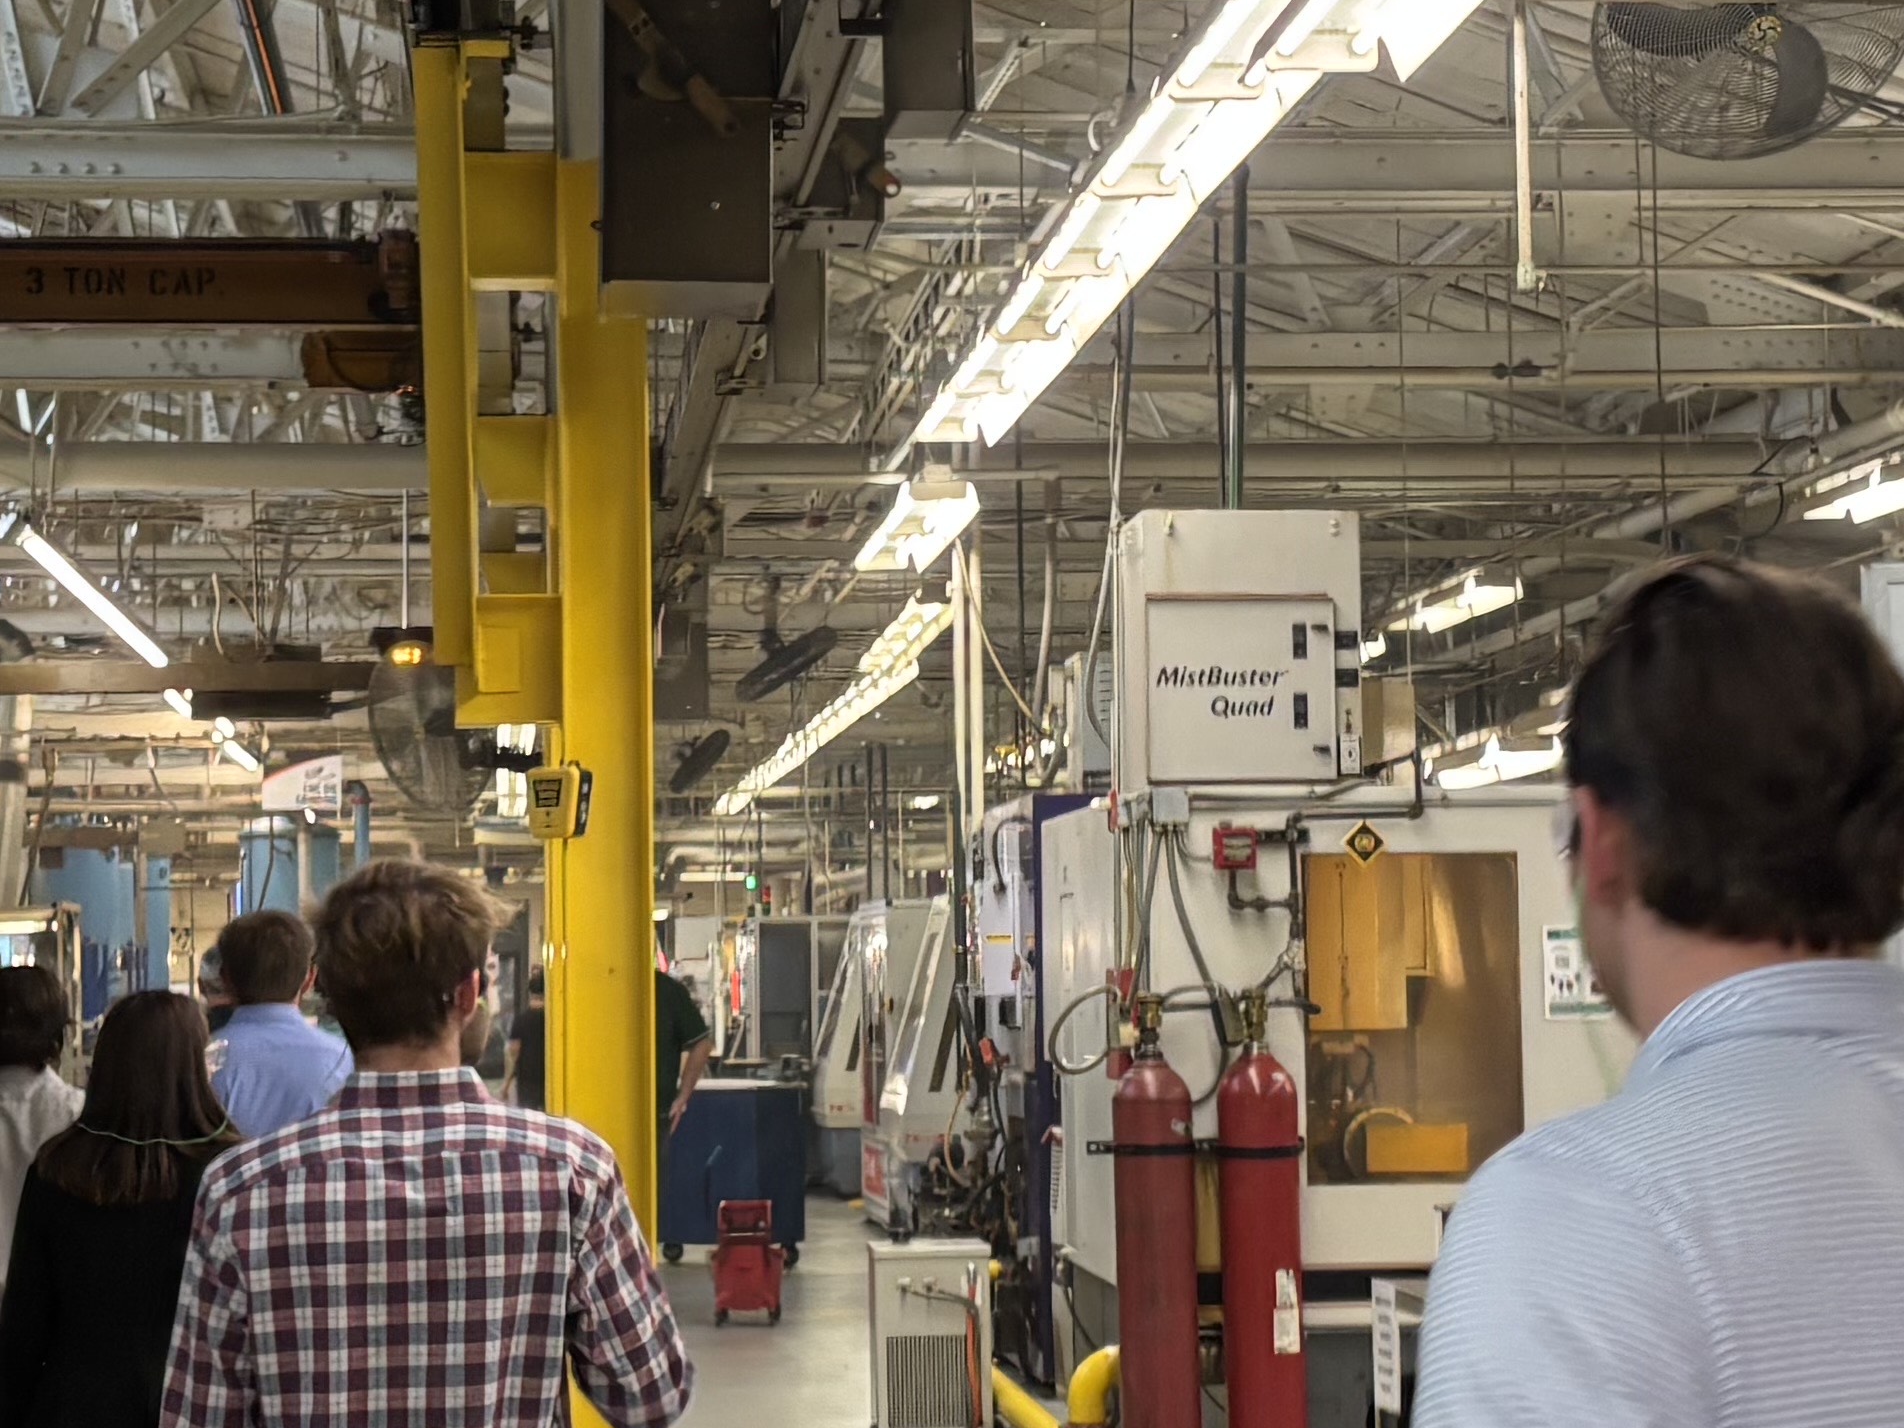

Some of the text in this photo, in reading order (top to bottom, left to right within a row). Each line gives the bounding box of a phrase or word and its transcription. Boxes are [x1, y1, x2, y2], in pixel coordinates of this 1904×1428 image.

[25, 266, 45, 295] 3
[63, 266, 126, 296] TON
[1155, 665, 1286, 688] MistBuster
[1210, 694, 1275, 720] Quad
